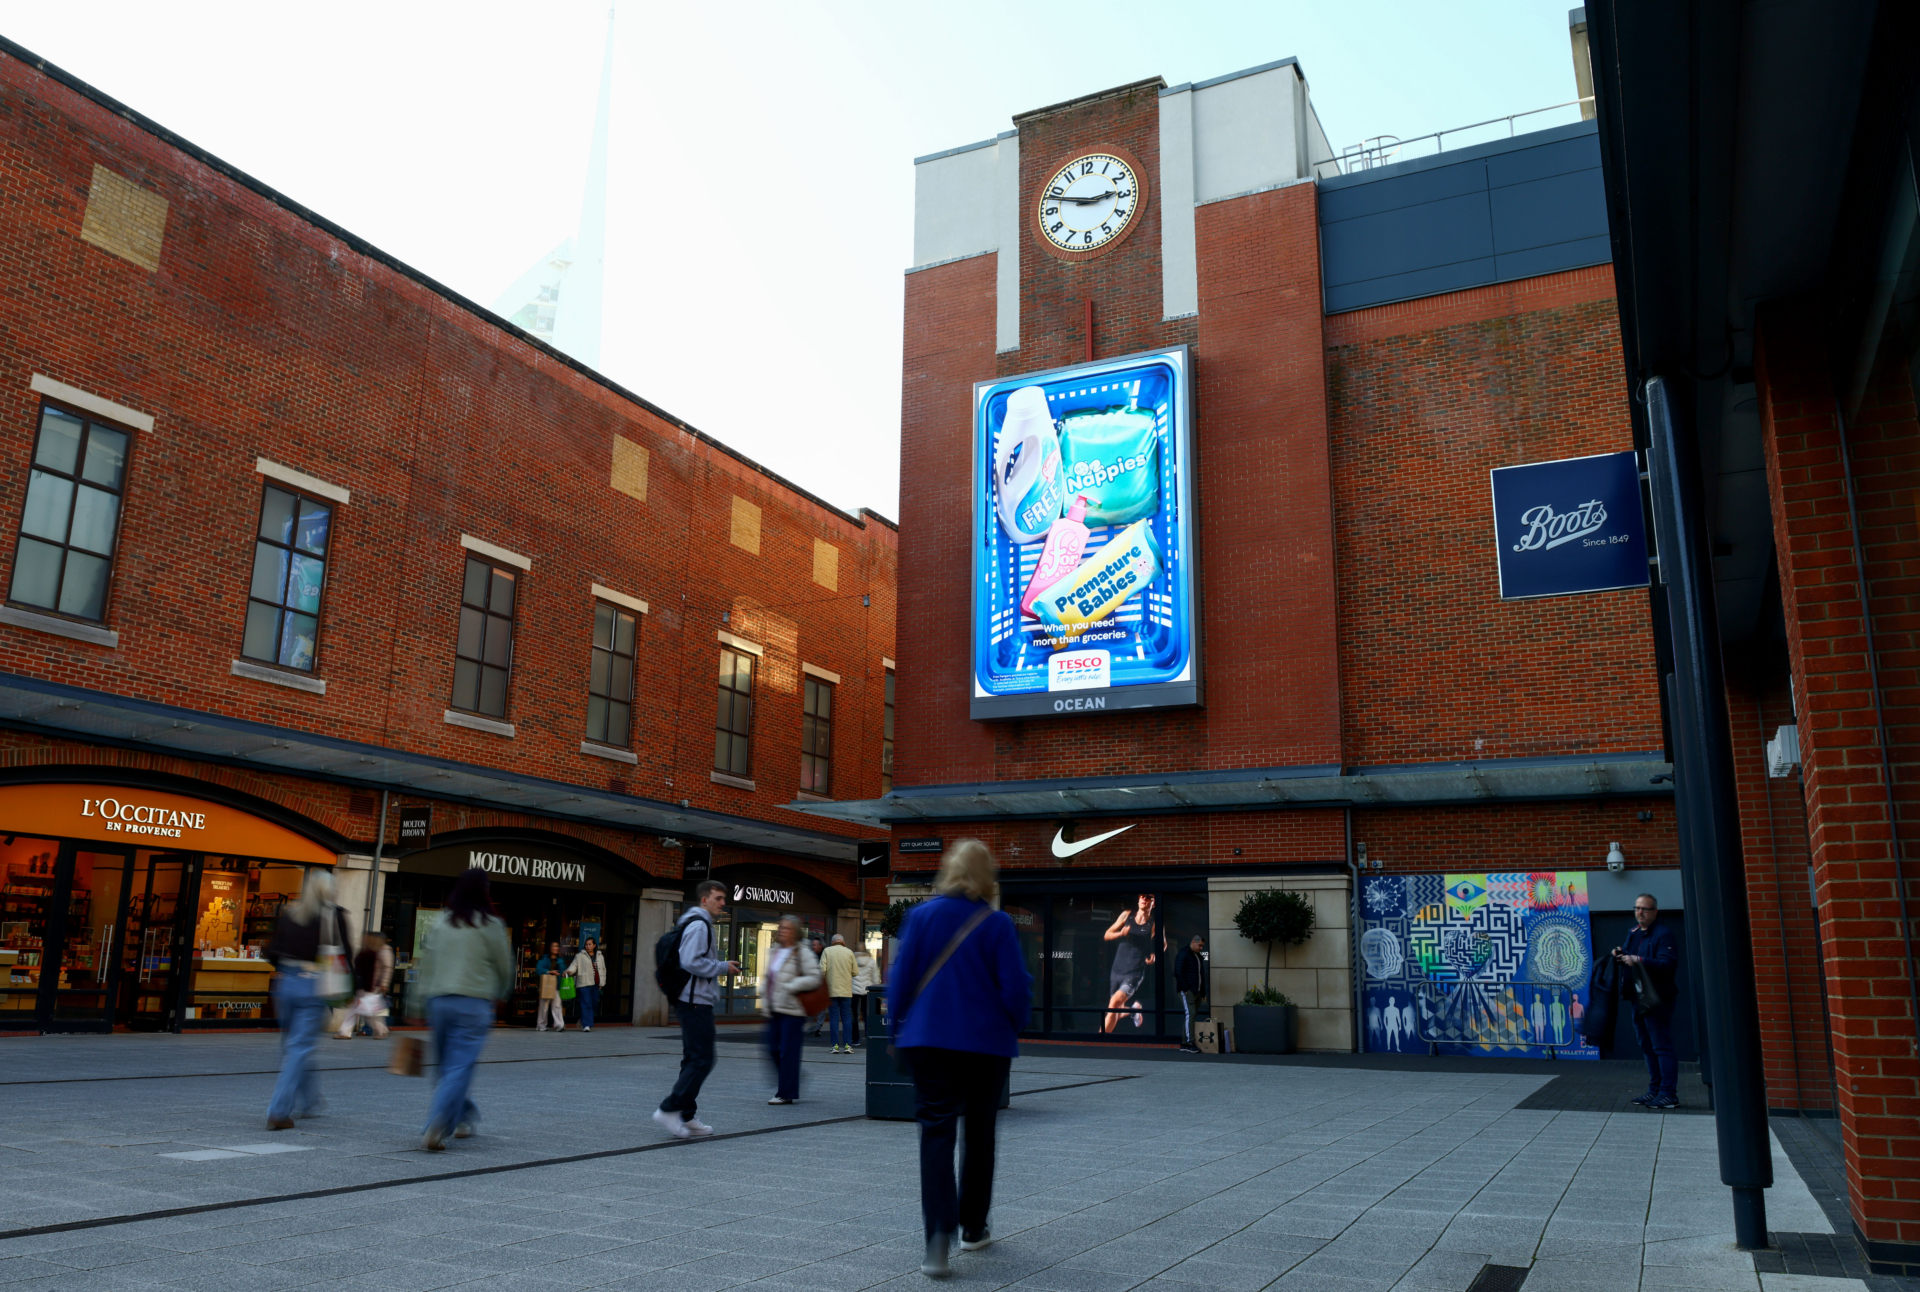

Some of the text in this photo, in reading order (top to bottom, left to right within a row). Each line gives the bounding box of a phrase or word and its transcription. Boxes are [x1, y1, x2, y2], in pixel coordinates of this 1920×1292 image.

[1081, 161, 1094, 176] 12
[1063, 170, 1076, 184] 11
[1111, 171, 1126, 185] 2
[1117, 189, 1131, 199] 3
[1045, 206, 1059, 216] 9
[1114, 208, 1126, 218] 4
[1050, 221, 1064, 234] 8
[1100, 222, 1112, 235] 5
[1064, 229, 1077, 243] 7
[1084, 230, 1093, 244] 6
[1066, 453, 1147, 494] Nappies
[1021, 479, 1061, 531] FREE
[1512, 499, 1608, 553] Boots
[1582, 534, 1630, 547] Since 1849
[1040, 529, 1080, 578] for
[1054, 546, 1142, 613] Premature
[1077, 570, 1137, 618] Babies
[1043, 618, 1115, 633] When you need
[1033, 630, 1127, 646] more than groceries
[1056, 656, 1102, 670] TESCO
[1056, 675, 1073, 684] Every
[1053, 696, 1106, 712] OCEAN
[81, 798, 206, 830] L'OCCITANE
[105, 821, 181, 838] EN PROVENCE
[402, 820, 427, 828] MOLTON
[401, 828, 426, 837] BROWN
[468, 850, 586, 883] MOLTON BROWN
[745, 886, 794, 905] SWAROVSKI
